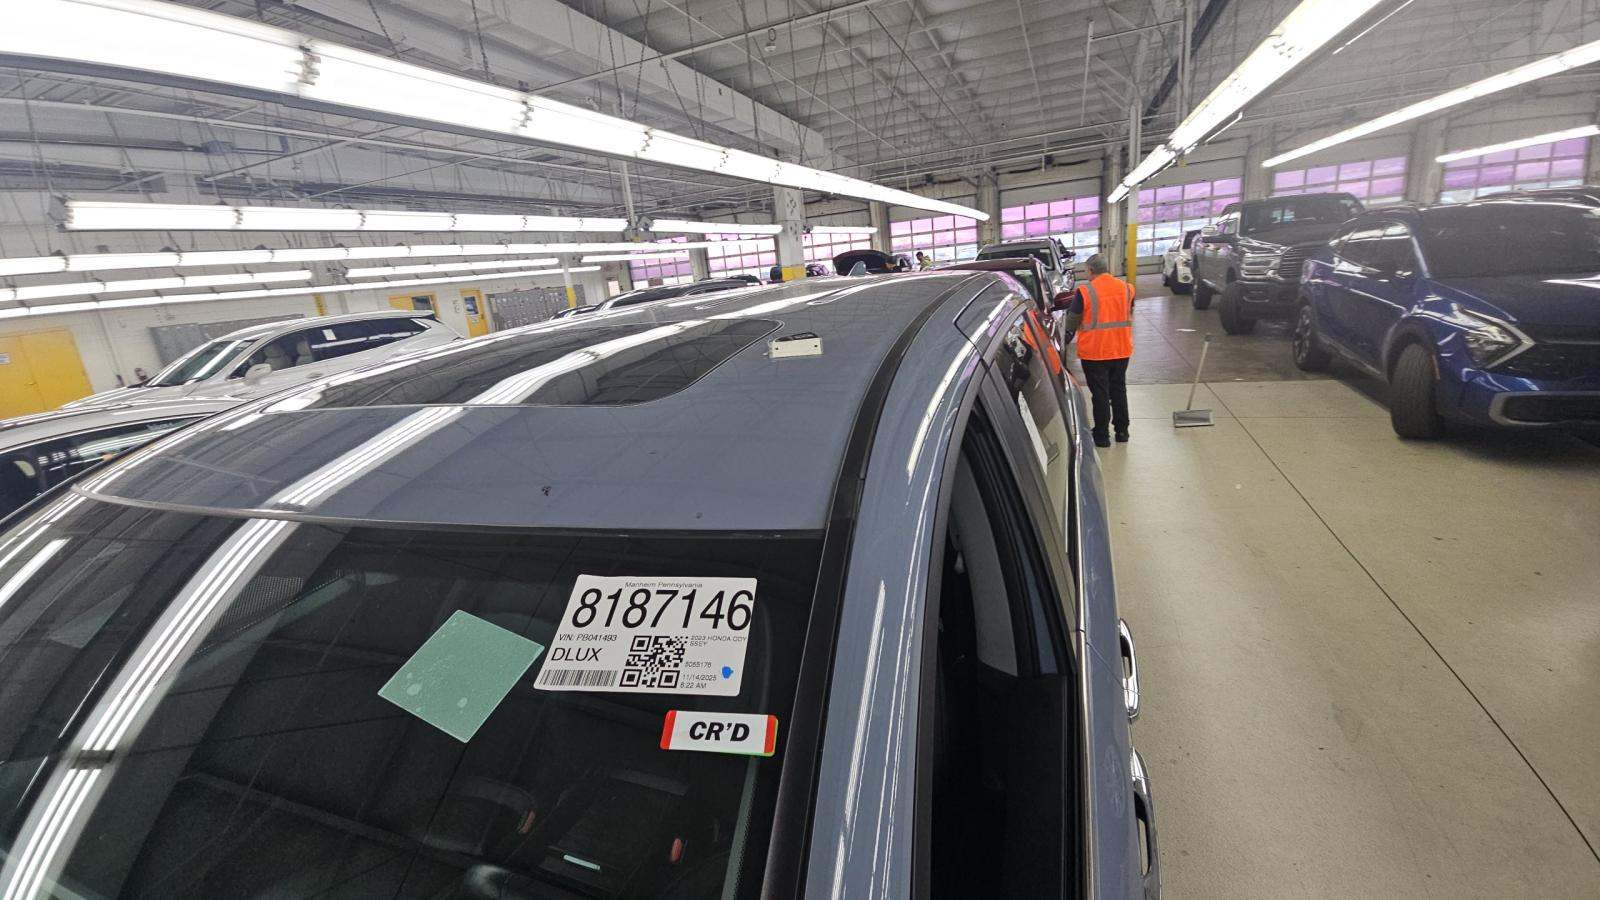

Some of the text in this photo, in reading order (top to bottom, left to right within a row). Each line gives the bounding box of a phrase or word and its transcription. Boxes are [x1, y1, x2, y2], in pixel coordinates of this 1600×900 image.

[625, 581, 703, 589] Manheim Pennsylvania
[571, 587, 754, 631] 8187146
[559, 633, 618, 642] VIN: PB041493
[551, 647, 603, 662] DLUX
